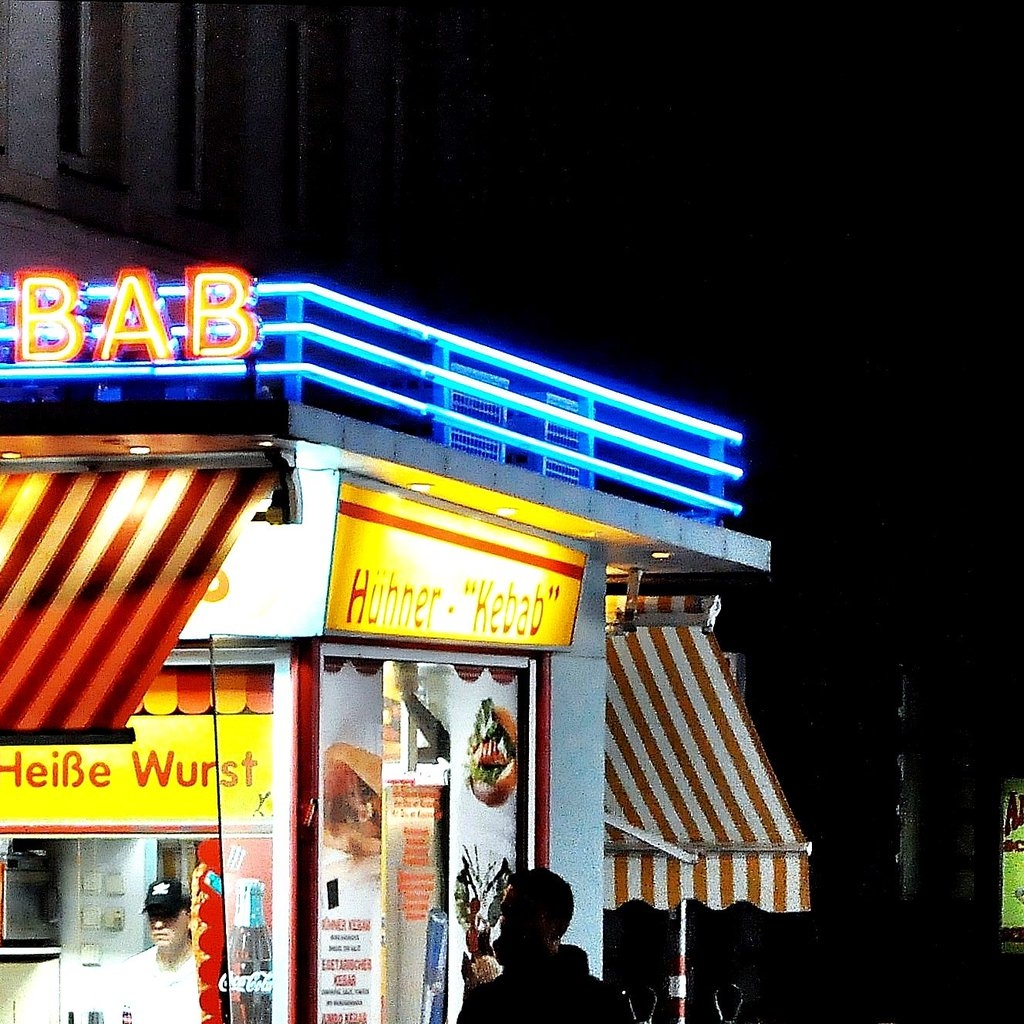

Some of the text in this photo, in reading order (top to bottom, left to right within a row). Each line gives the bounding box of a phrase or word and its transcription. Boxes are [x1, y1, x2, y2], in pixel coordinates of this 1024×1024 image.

[347, 568, 442, 629] Hühner
[464, 579, 561, 636] "Kebab"
[132, 750, 258, 788] Wurst
